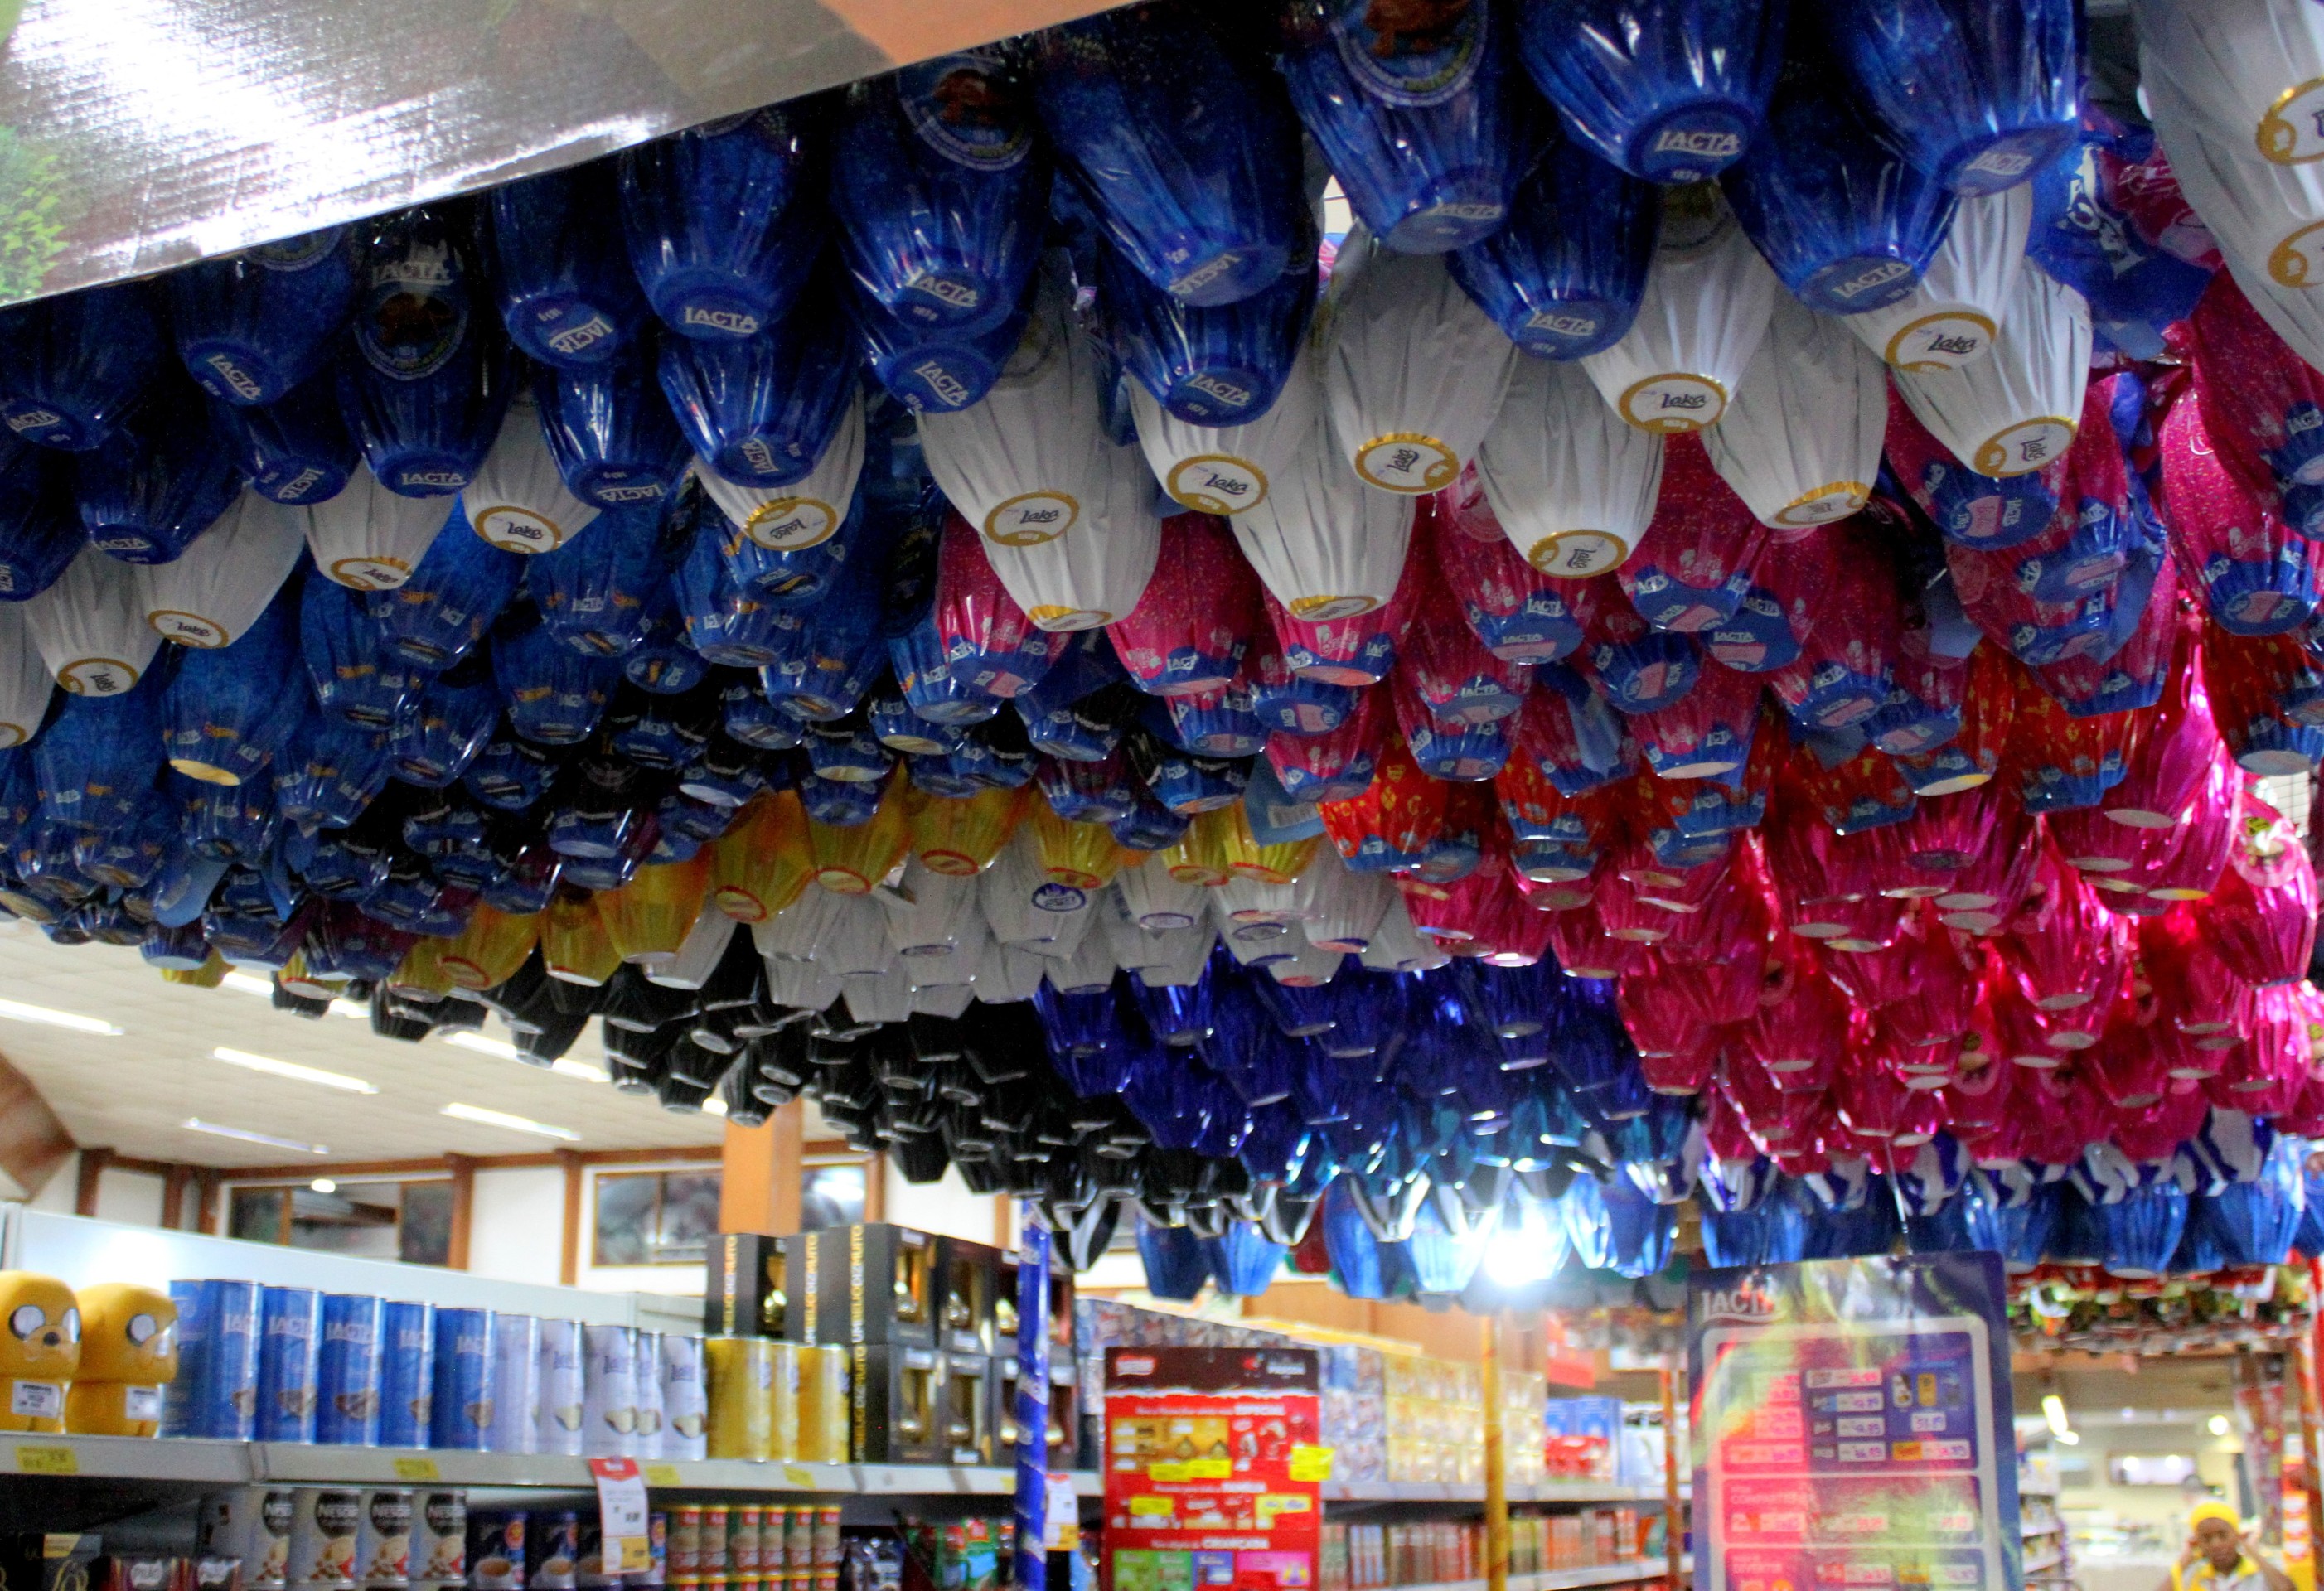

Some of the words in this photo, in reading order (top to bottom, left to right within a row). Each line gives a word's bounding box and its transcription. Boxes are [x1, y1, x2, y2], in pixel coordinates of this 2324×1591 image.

[1656, 130, 1742, 157] LACTA
[905, 268, 978, 307] LACTA
[1833, 259, 1915, 298] LACTA
[685, 307, 760, 334] LACTA
[1529, 312, 1596, 336] LACTA
[549, 316, 615, 355] LACTA
[1925, 333, 1978, 355] Laka
[207, 354, 263, 400] LACTA
[915, 360, 971, 407] LACTA
[1189, 372, 1252, 406] LACTA
[1658, 391, 1711, 410] Laka
[743, 437, 780, 474] LACTA
[1386, 447, 1421, 474] Laka
[2019, 436, 2046, 462] Laka
[401, 471, 467, 486] LACTA
[1203, 473, 1249, 497] Laka
[595, 483, 665, 503] LACTA
[1019, 507, 1061, 524] Laka
[506, 521, 544, 540] Laka
[769, 517, 810, 541] Laka
[1568, 546, 1598, 570] Laka
[1700, 1290, 1787, 1325] LACT
